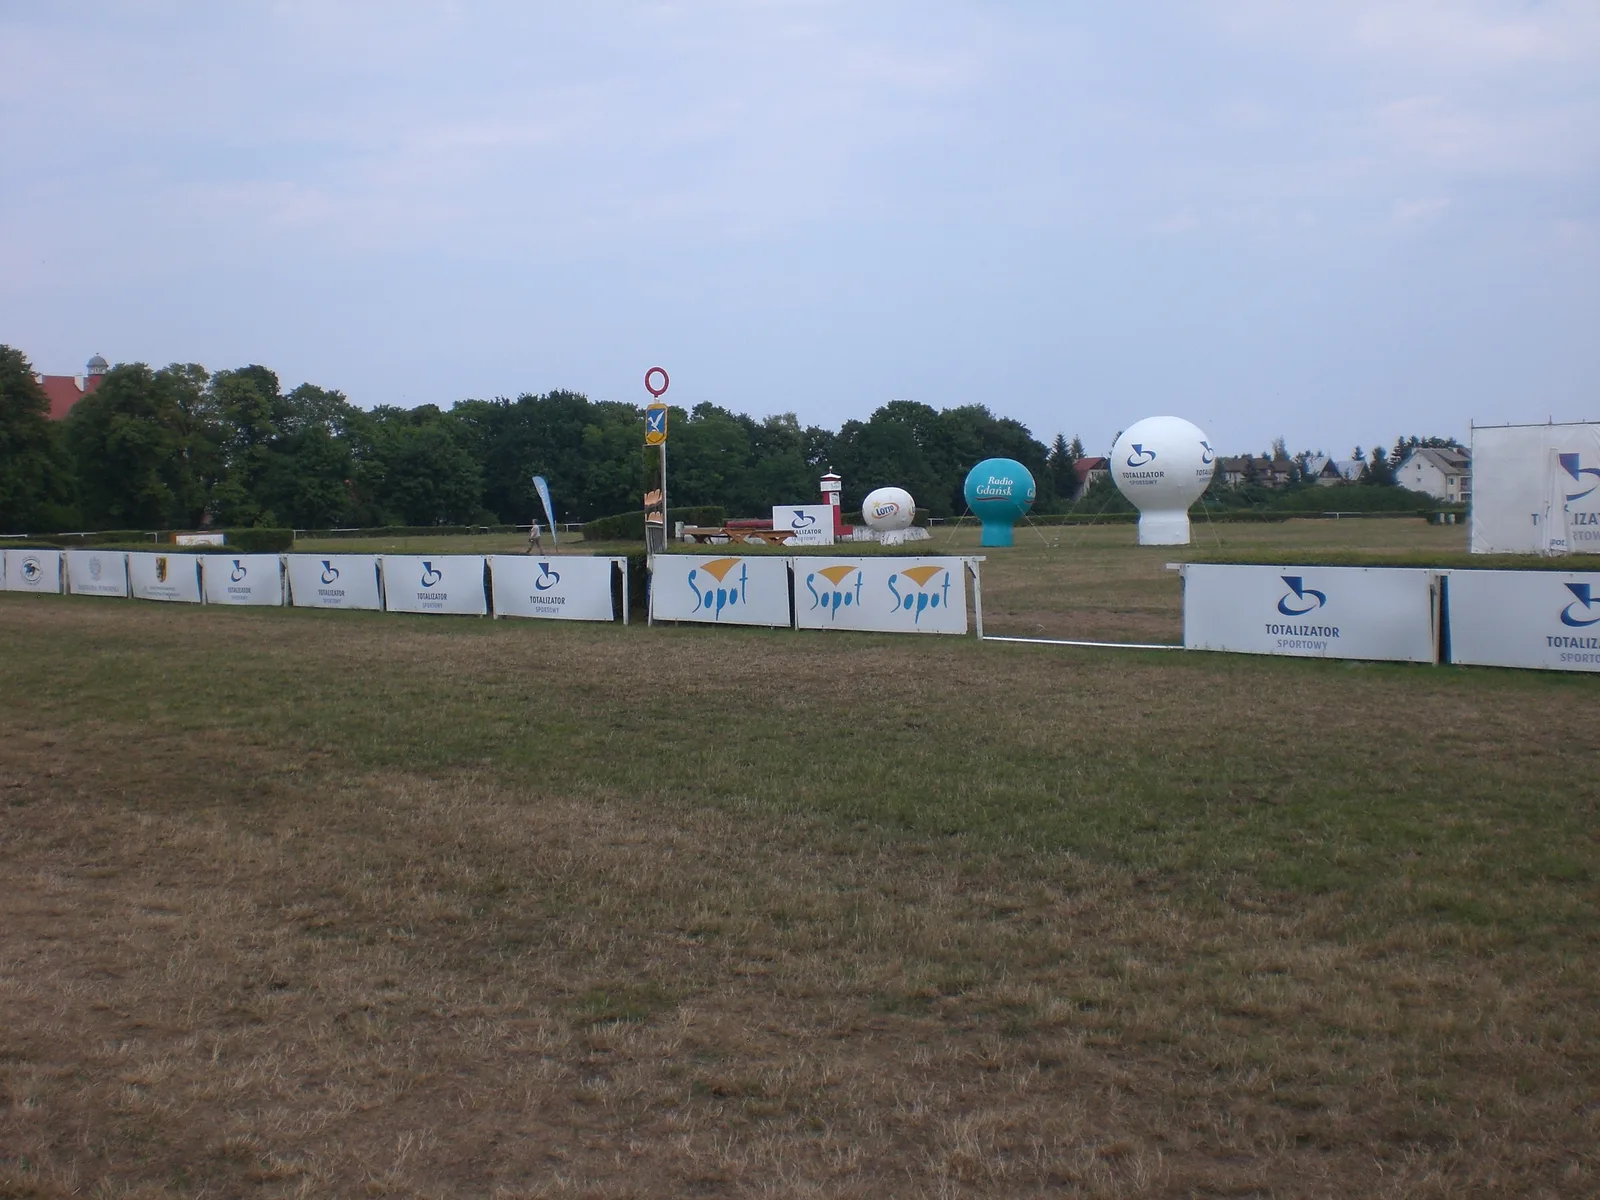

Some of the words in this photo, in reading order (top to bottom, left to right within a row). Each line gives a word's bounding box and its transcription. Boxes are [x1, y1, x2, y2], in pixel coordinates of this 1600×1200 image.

[1122, 471, 1164, 479] TOTALIZATOR
[988, 476, 1013, 486] Radio
[976, 485, 1013, 496] Gdańsk
[875, 505, 895, 516] LOTTO
[417, 592, 448, 600] TOTALIZATOR
[688, 563, 748, 621] Sopot
[806, 571, 863, 621] Sopot
[888, 571, 950, 624] Sopot
[530, 596, 566, 604] TOTALIZATOR
[1266, 624, 1340, 638] TOTALIZATOR
[1277, 639, 1328, 650] SPORTOWY
[1546, 636, 1600, 649] TOTALIZ
[1560, 652, 1600, 664] SPORTO
